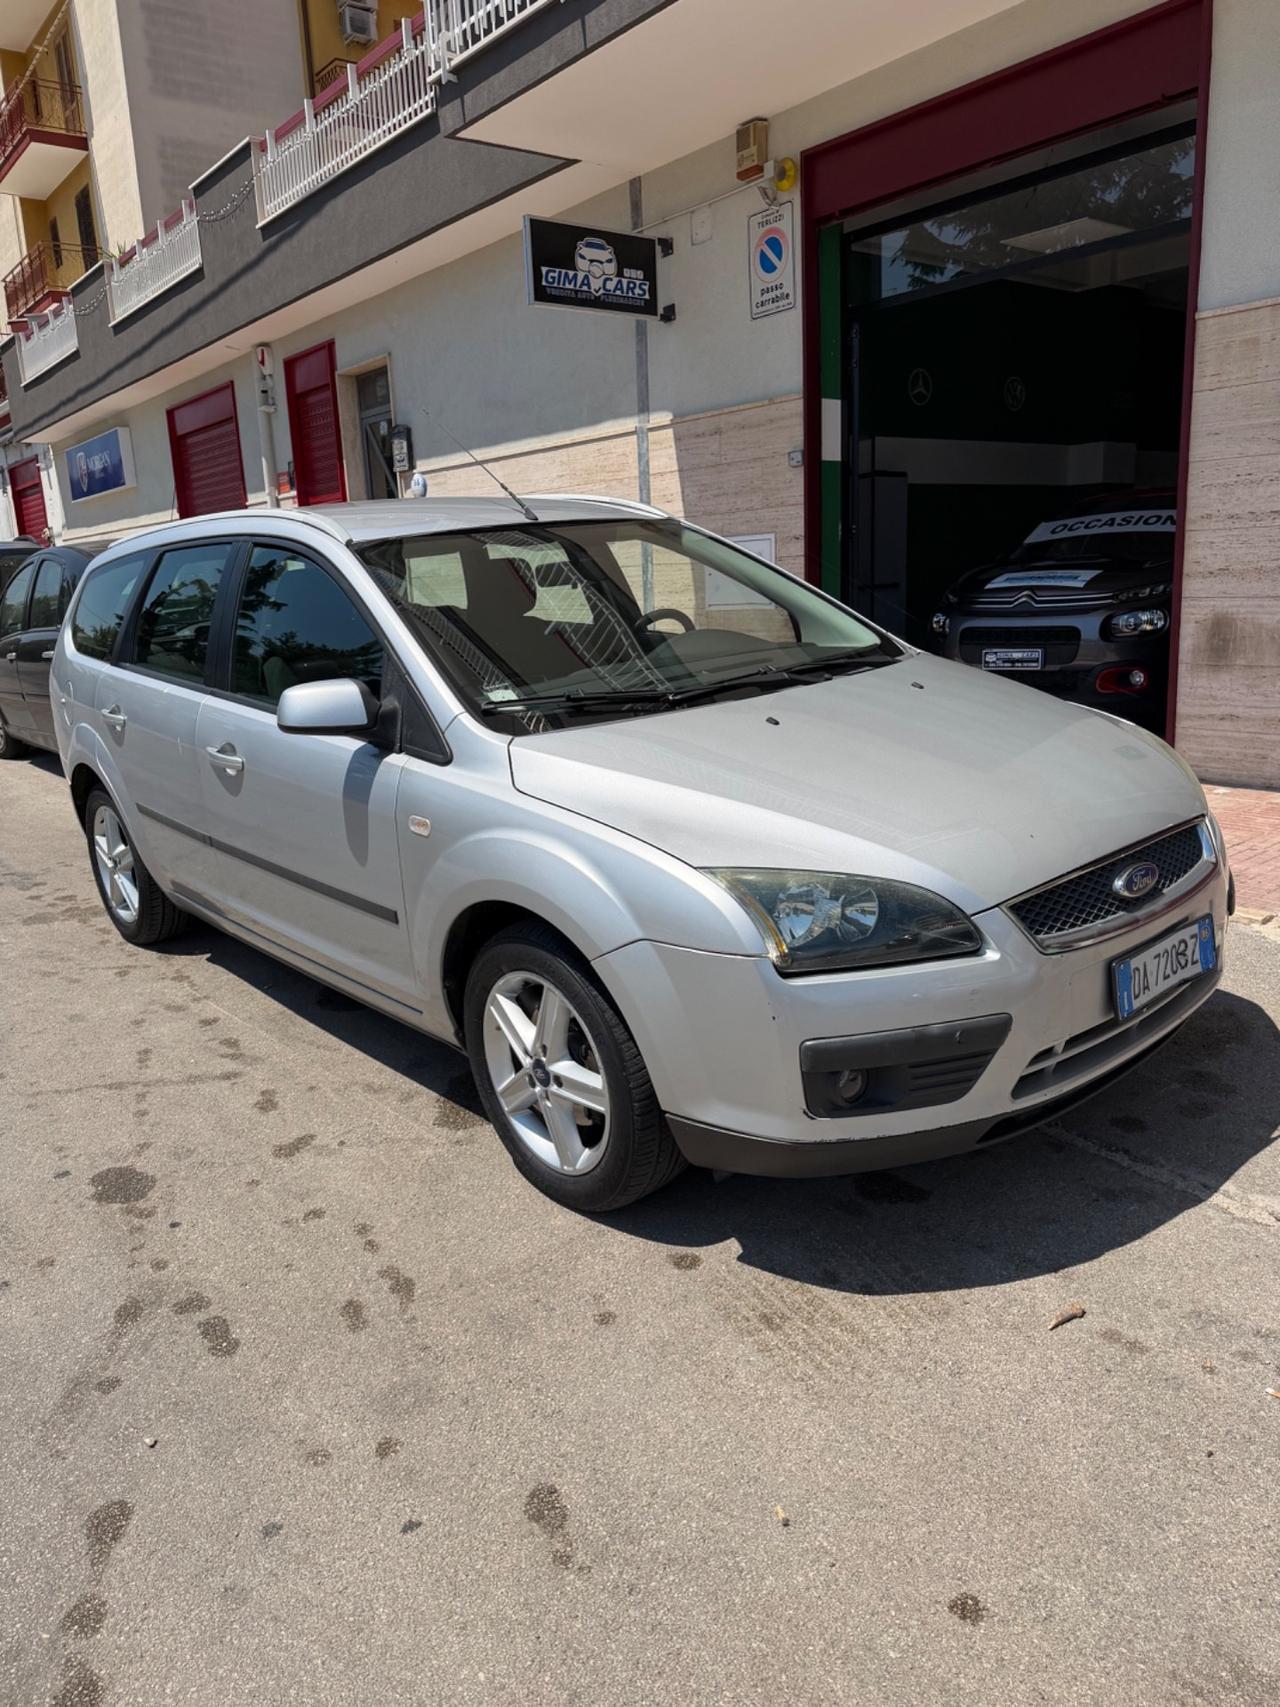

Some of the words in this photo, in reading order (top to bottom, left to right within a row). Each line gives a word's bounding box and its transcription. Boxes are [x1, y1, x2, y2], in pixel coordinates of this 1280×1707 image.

[757, 213, 785, 229] TERLIZZI
[544, 269, 592, 290] GIMA
[602, 277, 648, 298] CARS
[760, 282, 784, 297] passo
[755, 292, 790, 309] carrabile
[1132, 870, 1152, 891] Ford
[1133, 961, 1151, 1000] DA
